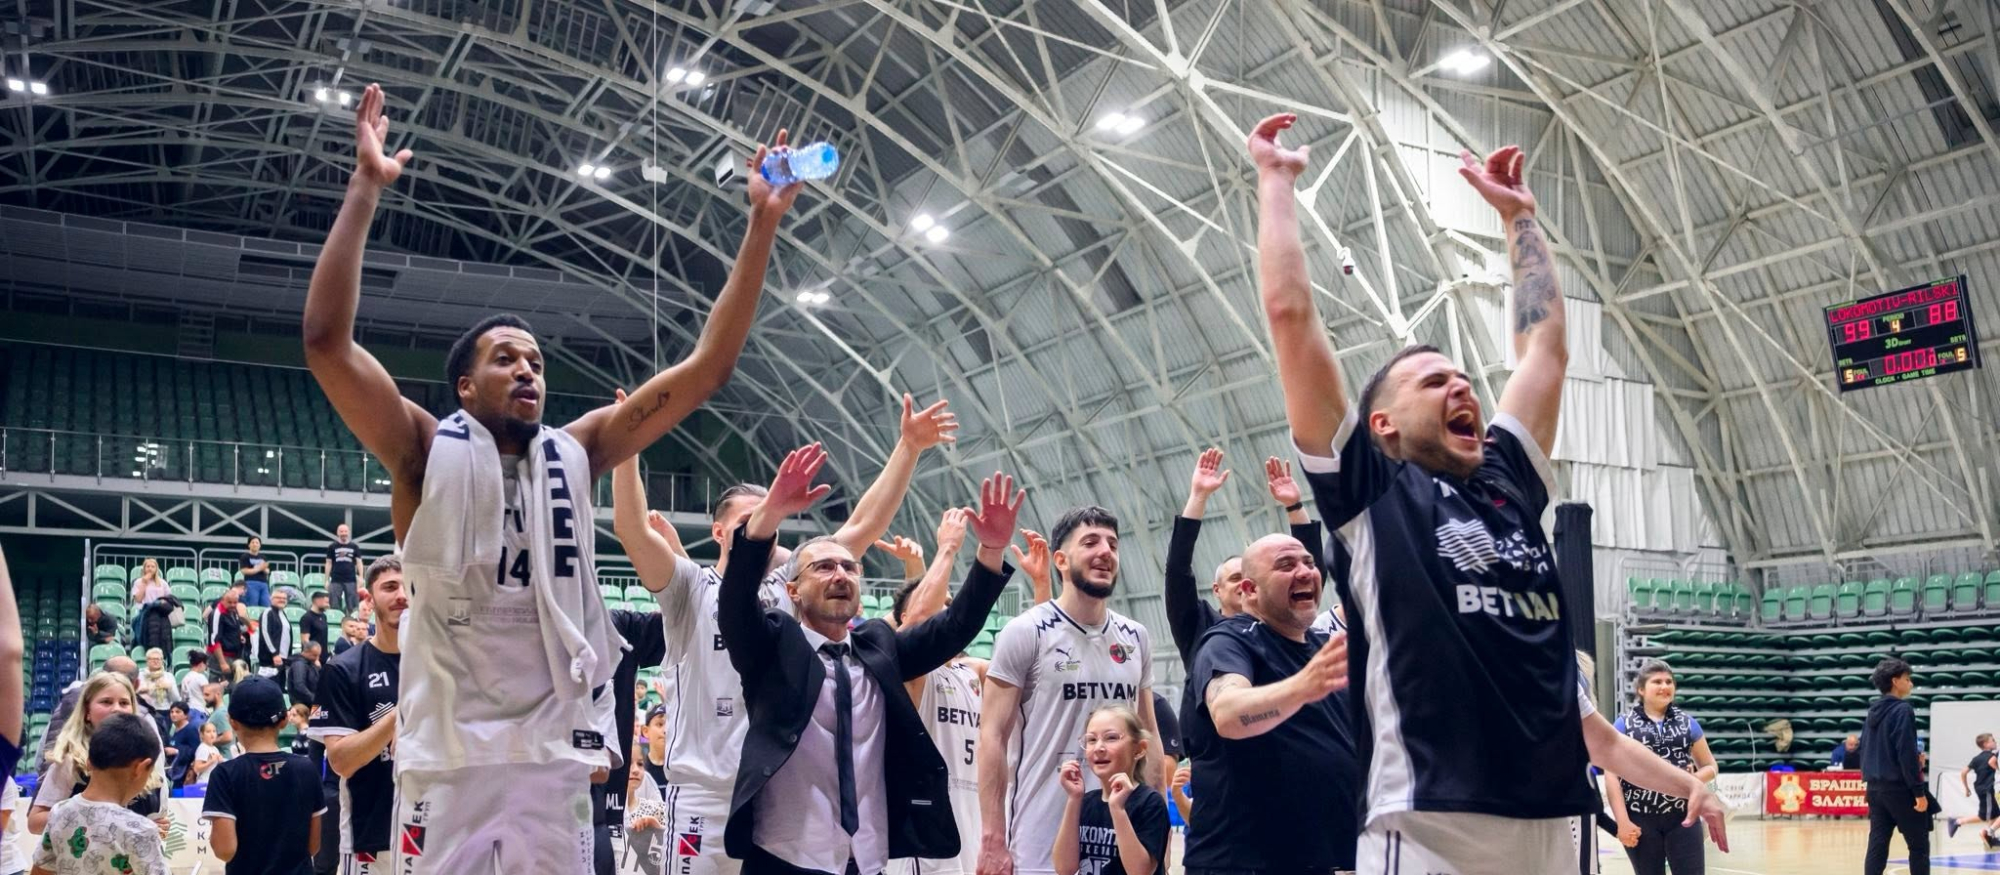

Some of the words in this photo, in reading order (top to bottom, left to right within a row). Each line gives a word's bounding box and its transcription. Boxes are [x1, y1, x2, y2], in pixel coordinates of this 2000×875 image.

[1929, 300, 1957, 325] 88
[1844, 320, 1870, 343] 99
[1891, 320, 1900, 334] 4
[1957, 347, 1966, 362] 5
[1844, 369, 1854, 383] 5
[497, 546, 531, 587] 14
[1456, 584, 1559, 621] BETVA
[368, 671, 390, 689] 21
[964, 739, 974, 766] 5
[1809, 779, 1867, 791] БРАШН
[1812, 795, 1868, 807] ЗЛАТИ
